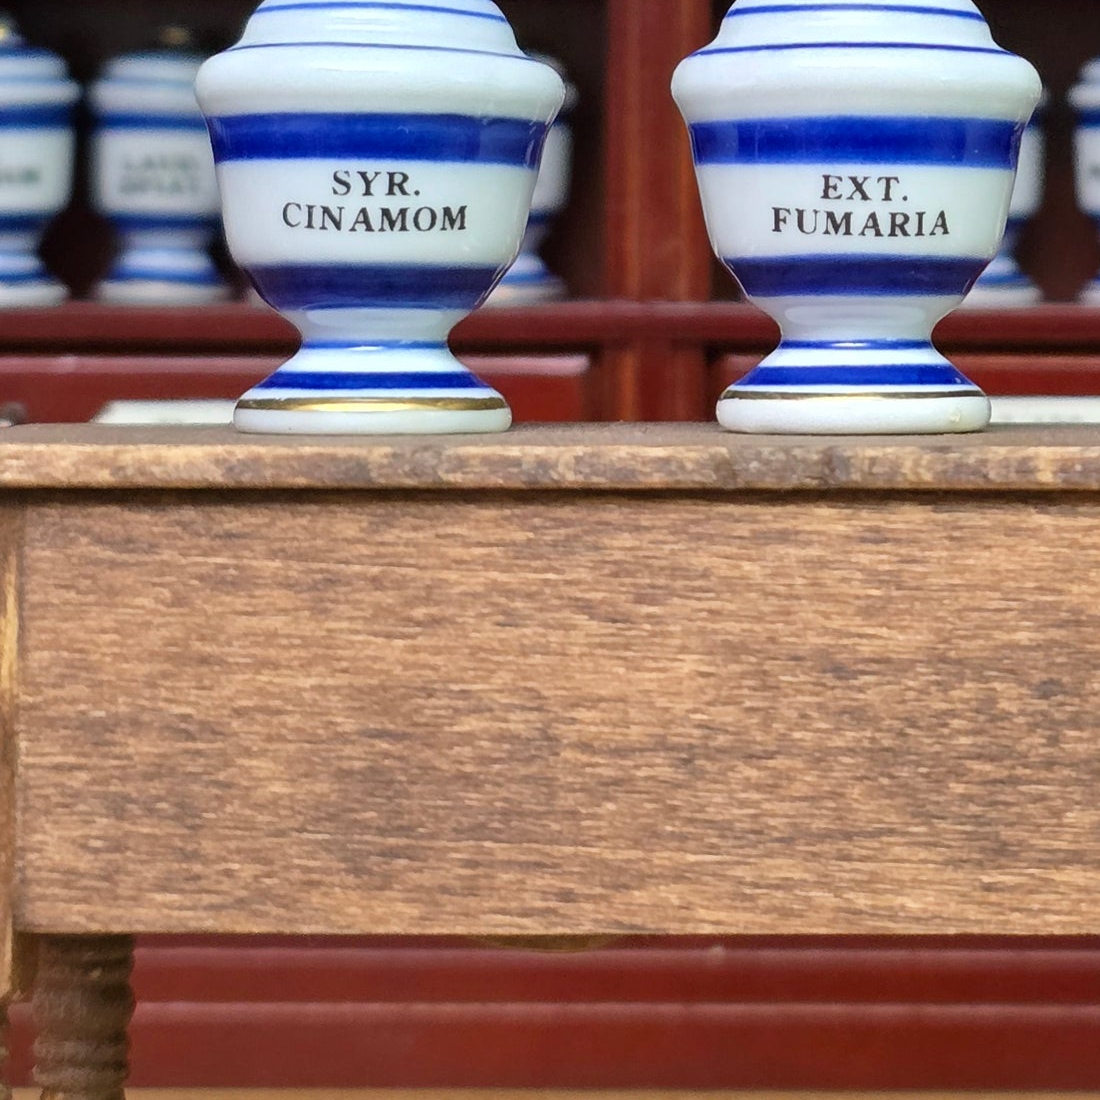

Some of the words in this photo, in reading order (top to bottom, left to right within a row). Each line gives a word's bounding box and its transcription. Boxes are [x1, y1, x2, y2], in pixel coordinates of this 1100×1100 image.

[332, 170, 420, 197] SYR.
[820, 174, 908, 202] EXT.
[282, 202, 468, 233] CINAMOM
[771, 206, 950, 238] FUMARIA
